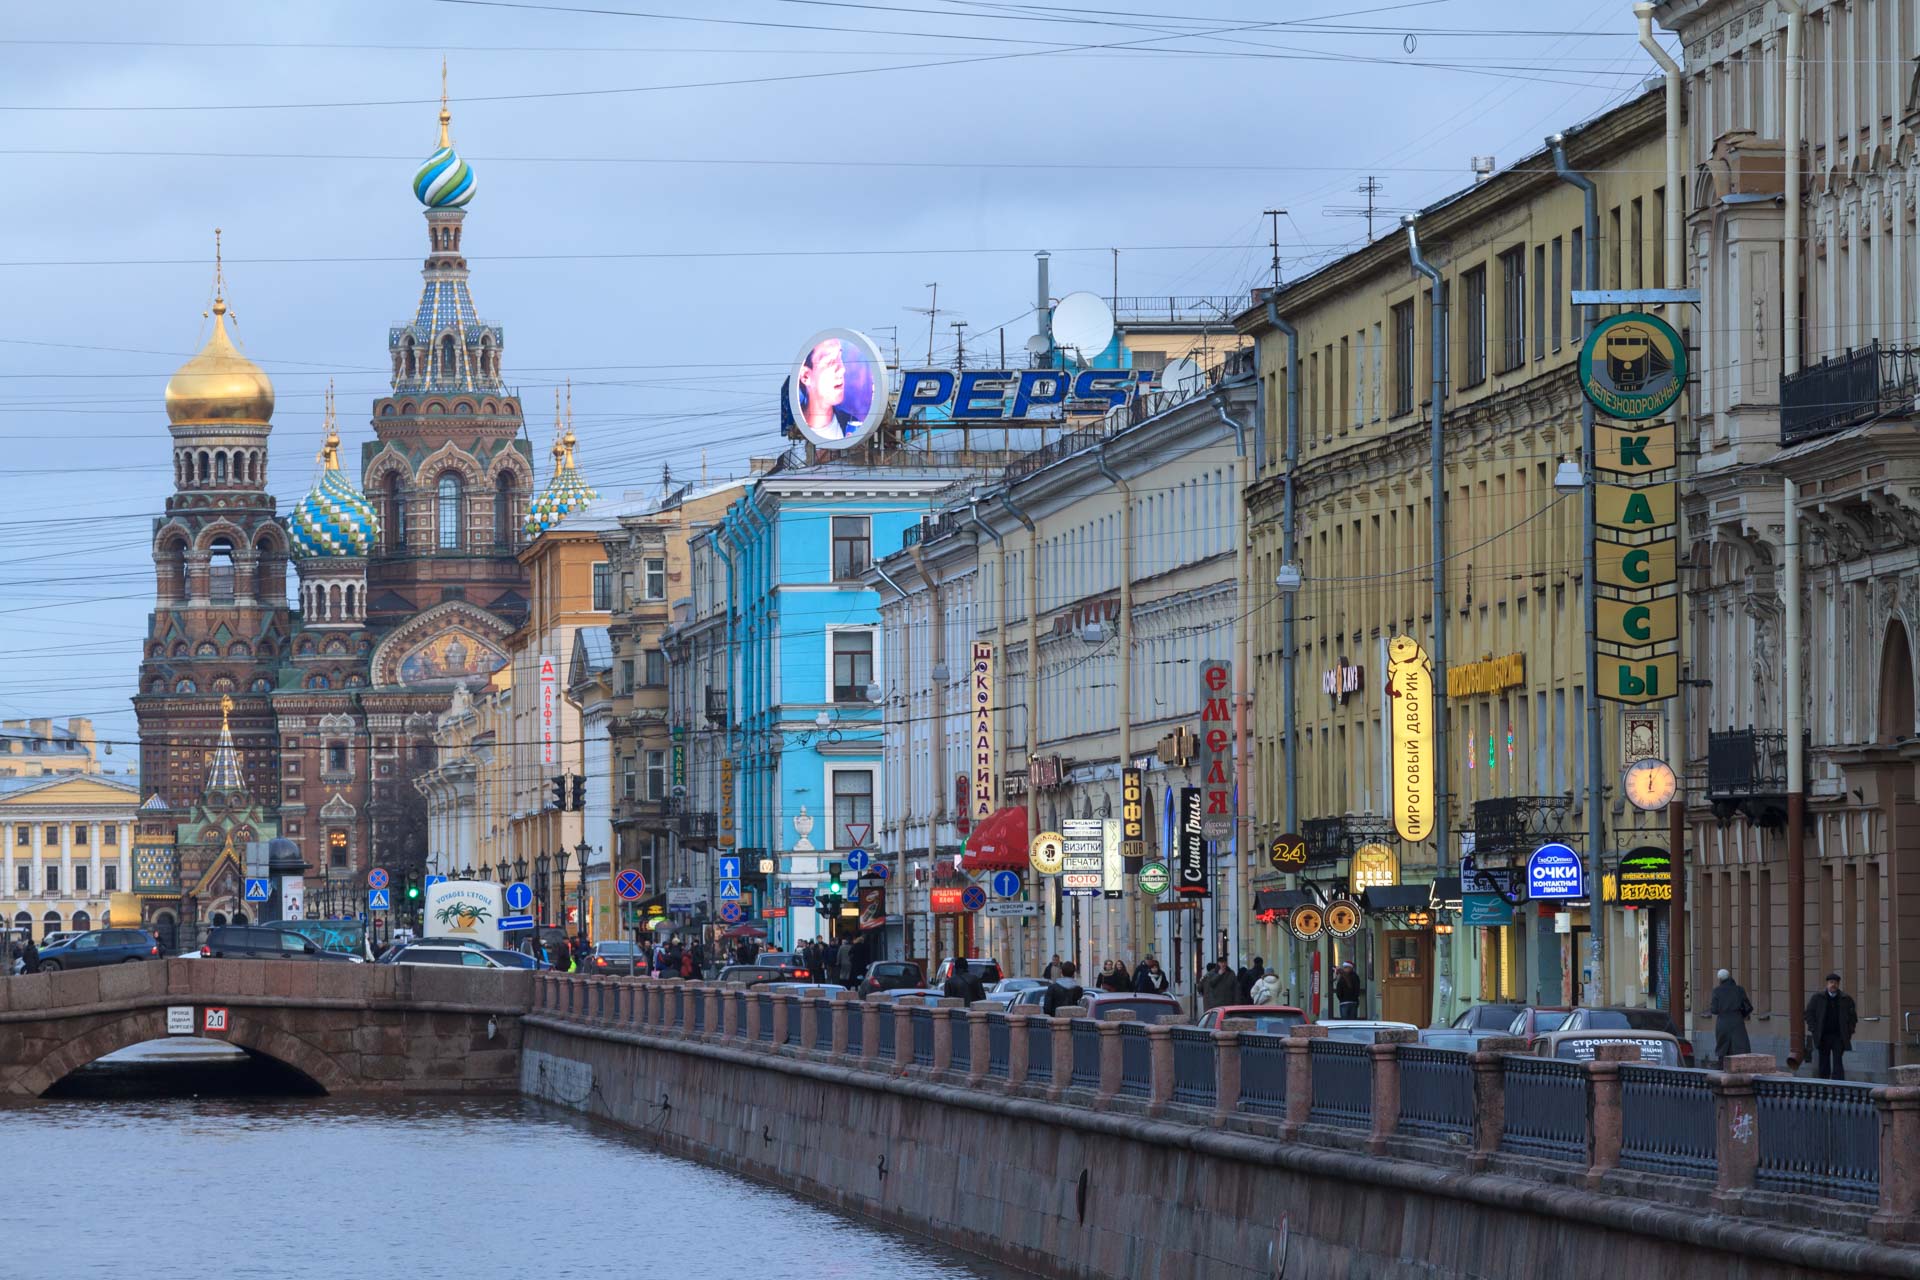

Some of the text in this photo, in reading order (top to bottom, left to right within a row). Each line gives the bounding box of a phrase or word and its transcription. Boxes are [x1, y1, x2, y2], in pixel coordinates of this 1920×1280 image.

[1587, 375, 1680, 417] ЖЕЛЕЗНОДОРОЖНЫЕ
[1618, 436, 1658, 696] КАССЫ
[1342, 665, 1358, 693] ХАУЗ
[973, 644, 991, 814] ШОКОЛАДНИЦА
[1404, 671, 1421, 835] ПИРОГОВЫЙ ДВОРИК
[721, 758, 733, 830] БИСТРО
[1064, 842, 1101, 852] ВИЗИТКИ
[1184, 793, 1202, 882] Сити Гриль
[1124, 842, 1144, 855] CLUB
[1273, 842, 1306, 863] 24
[1066, 857, 1099, 866] ПЕЧАТИ
[1356, 870, 1392, 880] BEER
[1533, 866, 1577, 879] ОЧКИ
[435, 891, 465, 904] VOYAGES
[208, 1015, 223, 1026] 2.0
